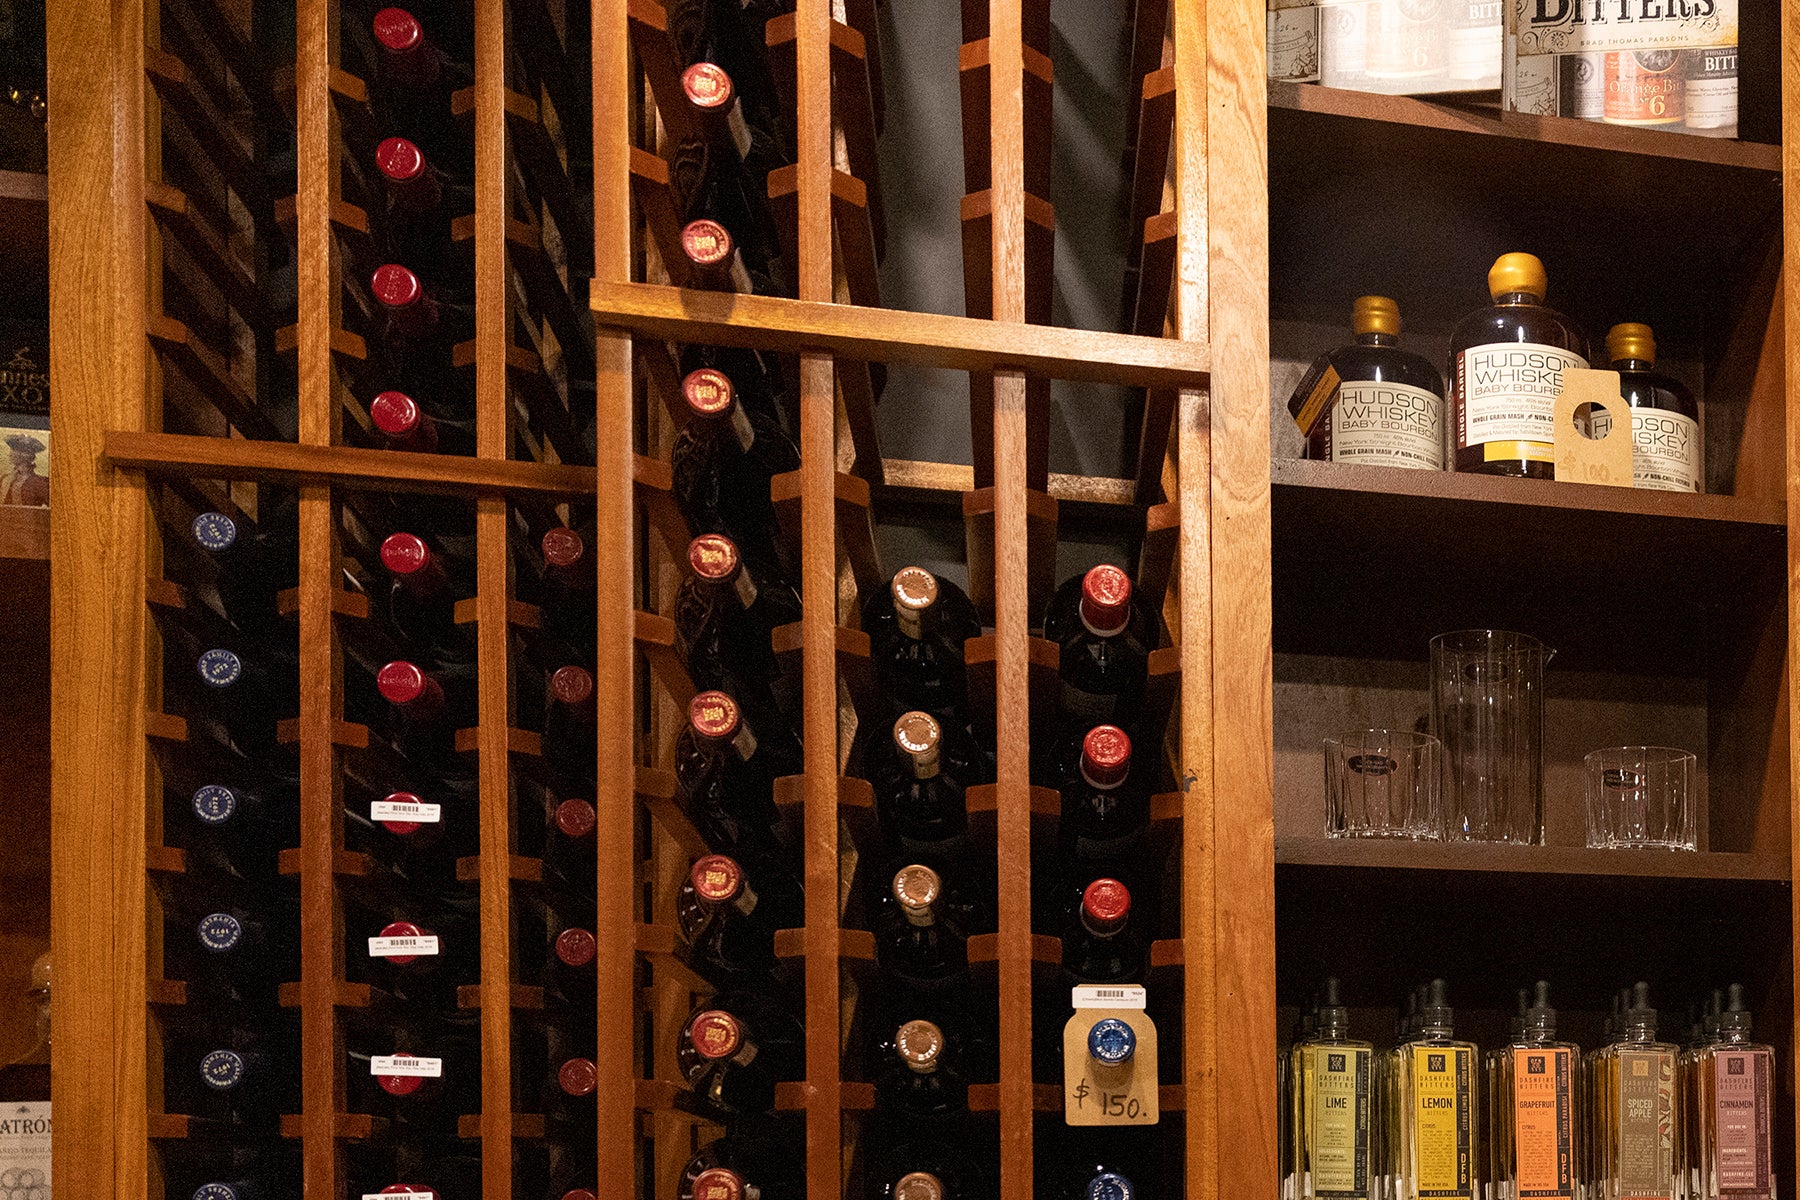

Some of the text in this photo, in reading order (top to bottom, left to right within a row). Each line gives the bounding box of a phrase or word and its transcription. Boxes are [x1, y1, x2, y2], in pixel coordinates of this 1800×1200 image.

[1607, 37, 1645, 46] THOMAS
[1648, 35, 1690, 44] PARSONS
[1609, 79, 1661, 98] Orange
[1650, 95, 1666, 116] 6
[1474, 383, 1563, 397] BABY BOURB
[1342, 391, 1438, 418] HUDSON
[1342, 406, 1438, 430] WHISKEY
[1342, 420, 1438, 442] BABY BOURBON
[1073, 1078, 1147, 1119] $ 150.
[1325, 1097, 1347, 1109] LIME
[1422, 1097, 1453, 1109] LEMON
[1520, 1100, 1555, 1109] GRAPEFRUIT
[1627, 1098, 1653, 1109] SPICED
[1719, 1100, 1754, 1109] CINNAMON
[1629, 1108, 1652, 1119] APPLE
